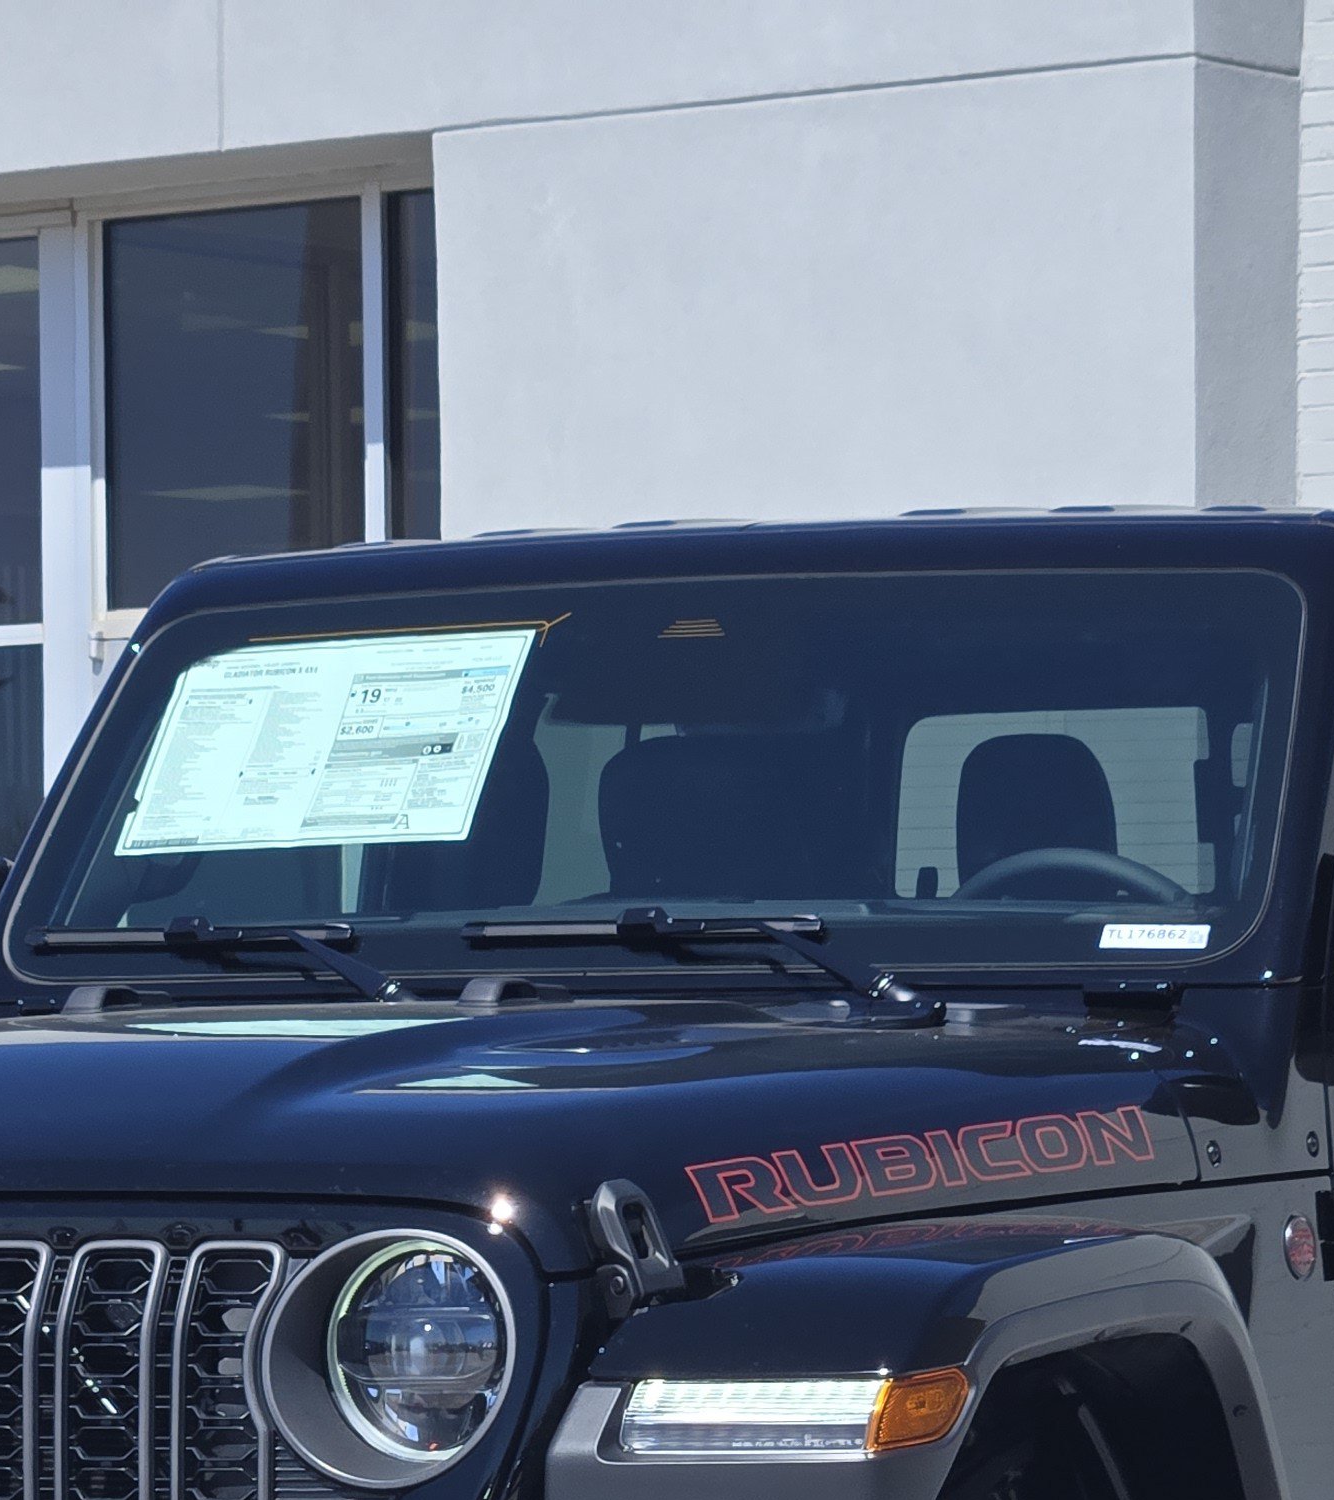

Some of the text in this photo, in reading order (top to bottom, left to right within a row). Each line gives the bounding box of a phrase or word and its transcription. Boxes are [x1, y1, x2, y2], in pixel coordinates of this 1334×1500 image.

[224, 669, 264, 678] GLADIATOR
[264, 667, 297, 676] RUBICON
[361, 688, 382, 704] 19
[340, 725, 374, 736] $2,600
[1108, 928, 1187, 940] TL176862
[685, 1105, 1154, 1224] RUBICON
